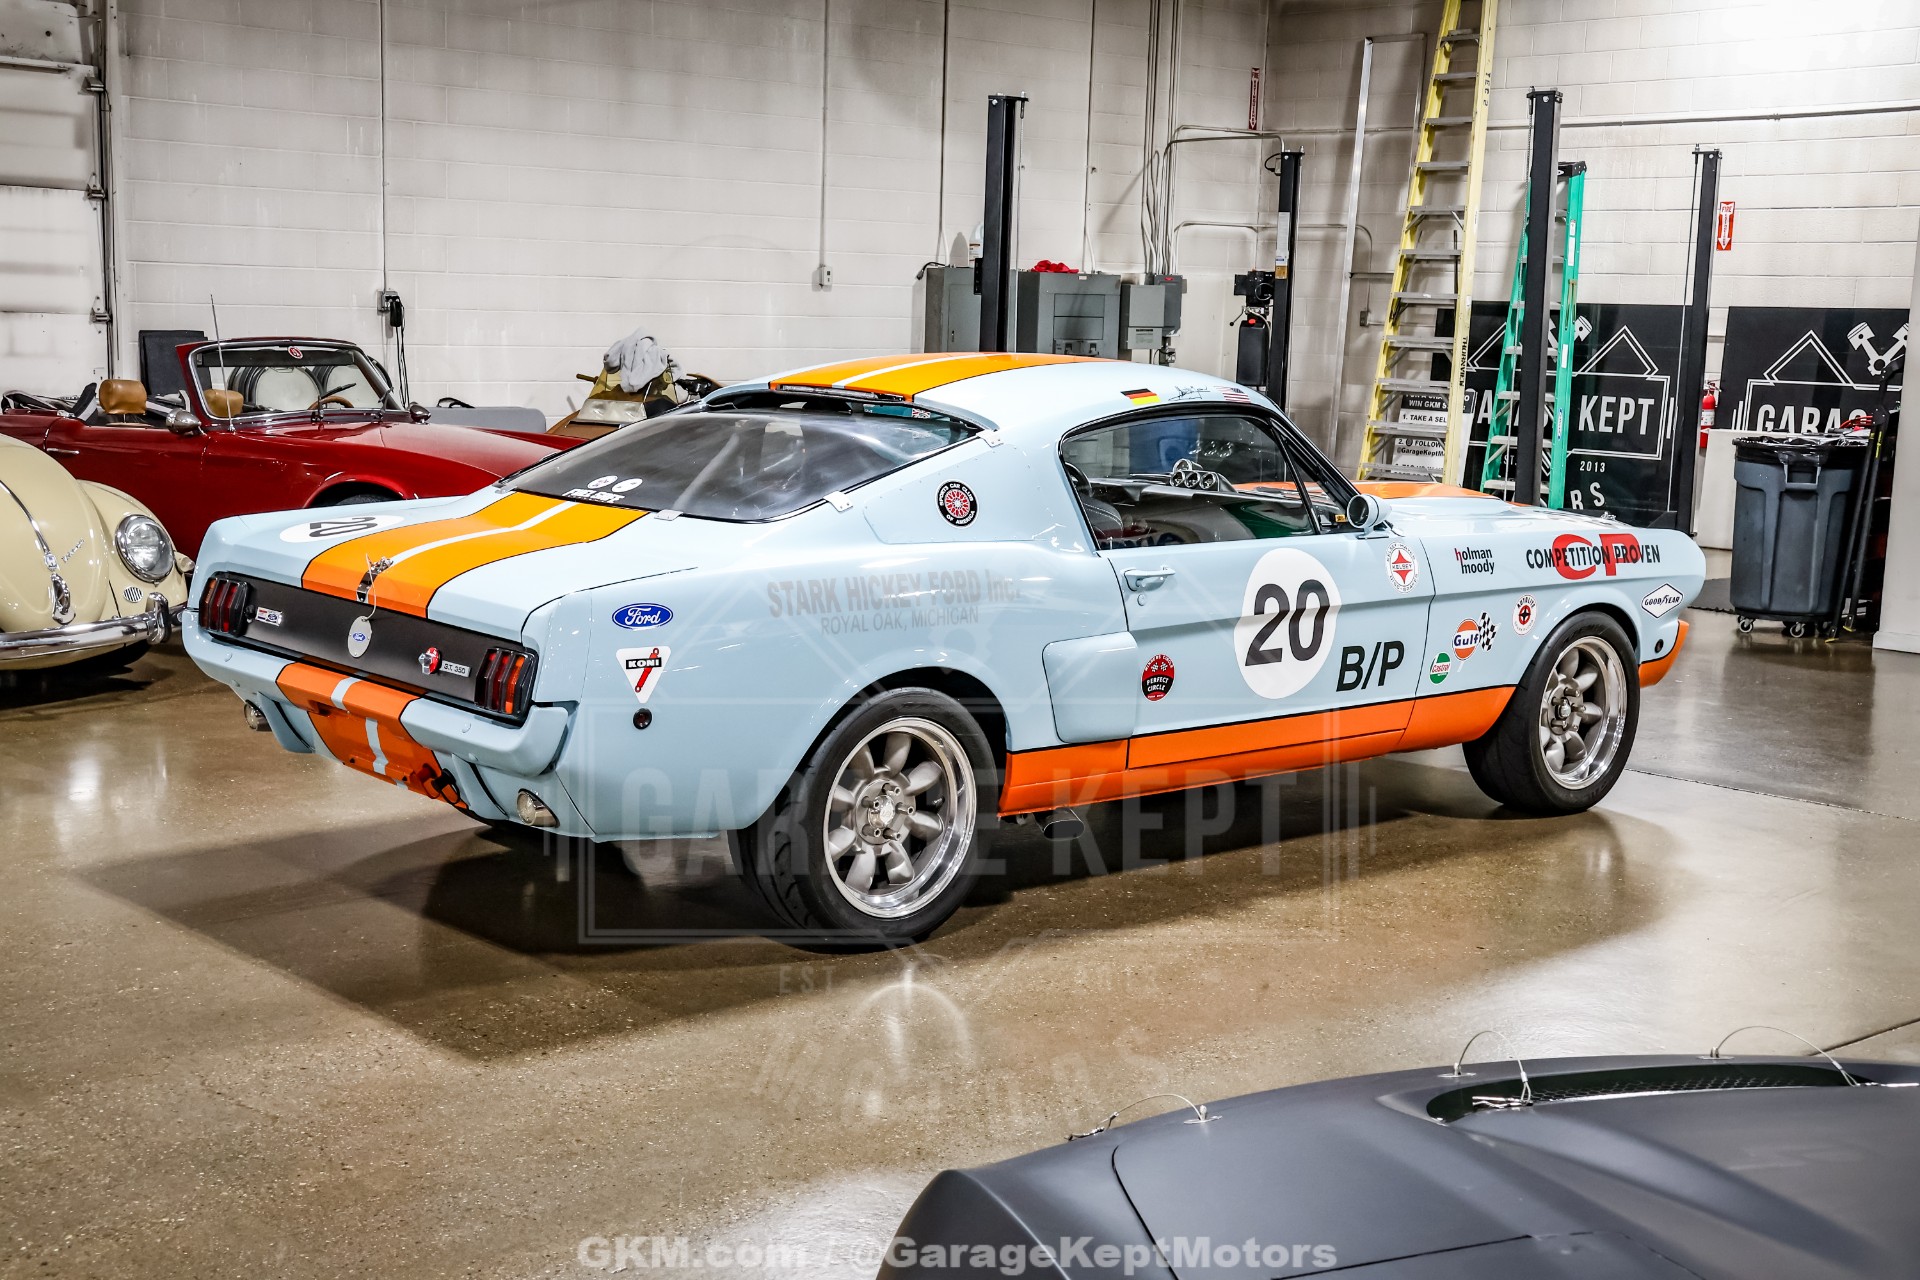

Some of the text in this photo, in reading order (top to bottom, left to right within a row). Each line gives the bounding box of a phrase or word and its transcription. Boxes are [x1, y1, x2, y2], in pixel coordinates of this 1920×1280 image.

[1459, 337, 1468, 387] THORNVIEW
[1409, 399, 1423, 407] WIN
[1424, 401, 1441, 409] GKM
[1410, 414, 1427, 422] TAKE
[1578, 394, 1655, 435] KEPT
[1579, 460, 1606, 473] 2013
[309, 516, 379, 538] 20
[1454, 546, 1493, 562] holman
[1526, 544, 1662, 570] COMPETITION PROVEN
[1461, 559, 1495, 575] moody
[766, 578, 842, 618] STARK
[843, 572, 922, 612] HICKEY
[927, 570, 982, 605] FORD
[624, 606, 661, 625] Ford
[820, 605, 980, 637] ROYAL OAK, MICHIGAN
[1244, 578, 1331, 667] 20
[1453, 633, 1480, 647] Gulf
[627, 658, 661, 668] KONI
[1336, 640, 1405, 692] B/P
[1146, 676, 1169, 686] PERFECT
[1147, 684, 1166, 692] CIRCLE
